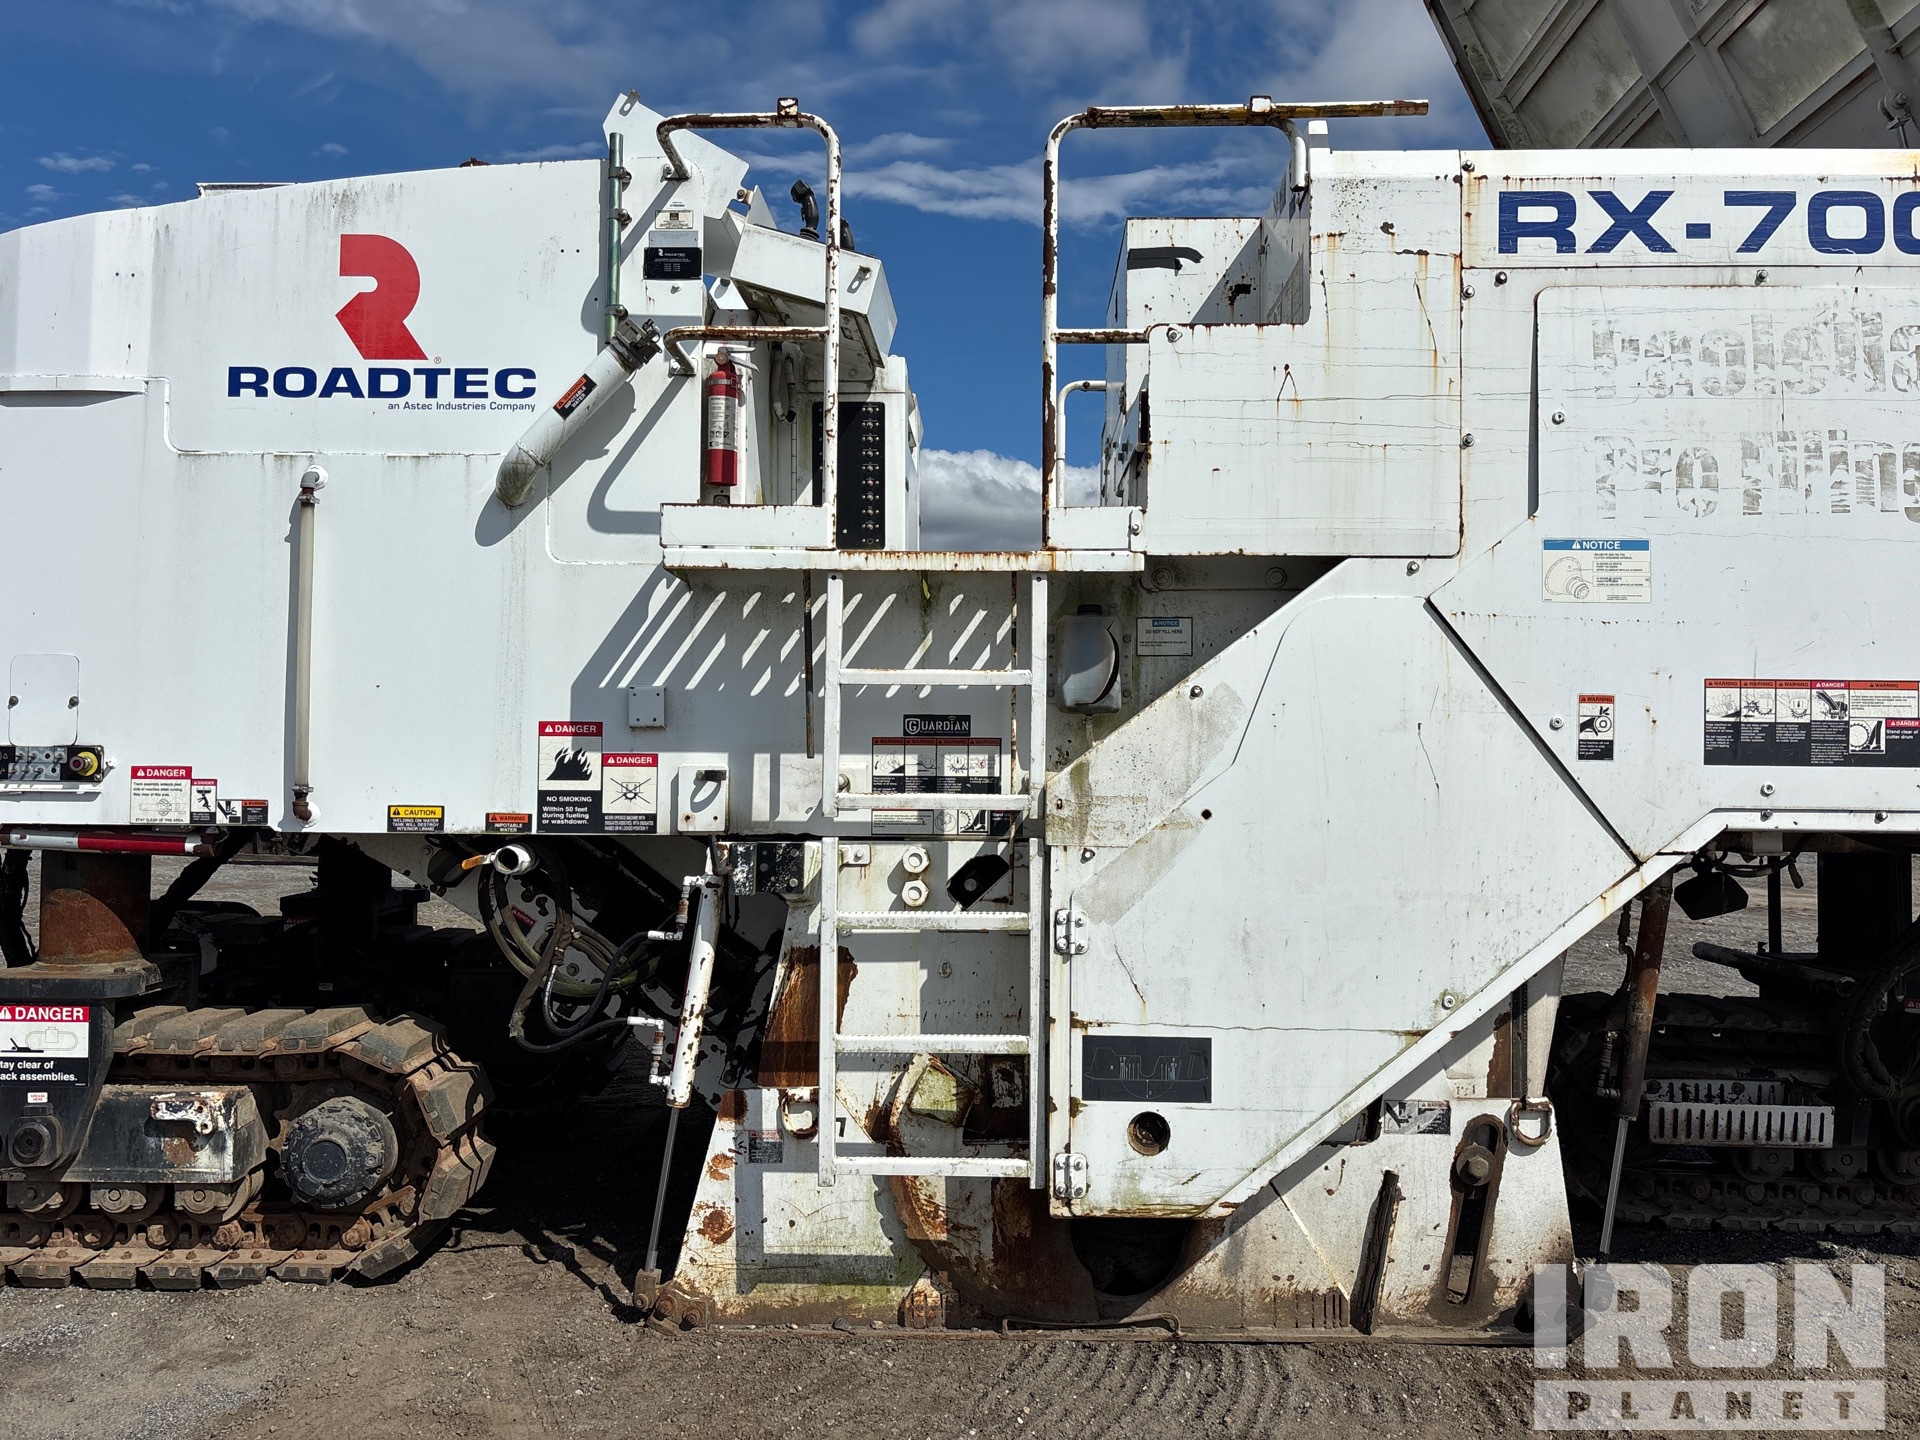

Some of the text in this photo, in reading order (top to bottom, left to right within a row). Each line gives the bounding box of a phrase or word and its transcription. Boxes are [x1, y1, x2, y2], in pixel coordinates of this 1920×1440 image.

[227, 366, 537, 399] ROADTEC
[403, 402, 432, 411] Astec
[436, 402, 486, 411] Industries
[490, 402, 536, 412] Company
[1582, 541, 1621, 550] NOTICE
[516, 912, 534, 926] DANGER
[15, 1008, 84, 1021] DANGER
[17, 1060, 41, 1069] clear
[44, 1060, 54, 1069] of
[20, 1072, 78, 1081] assemblies.
